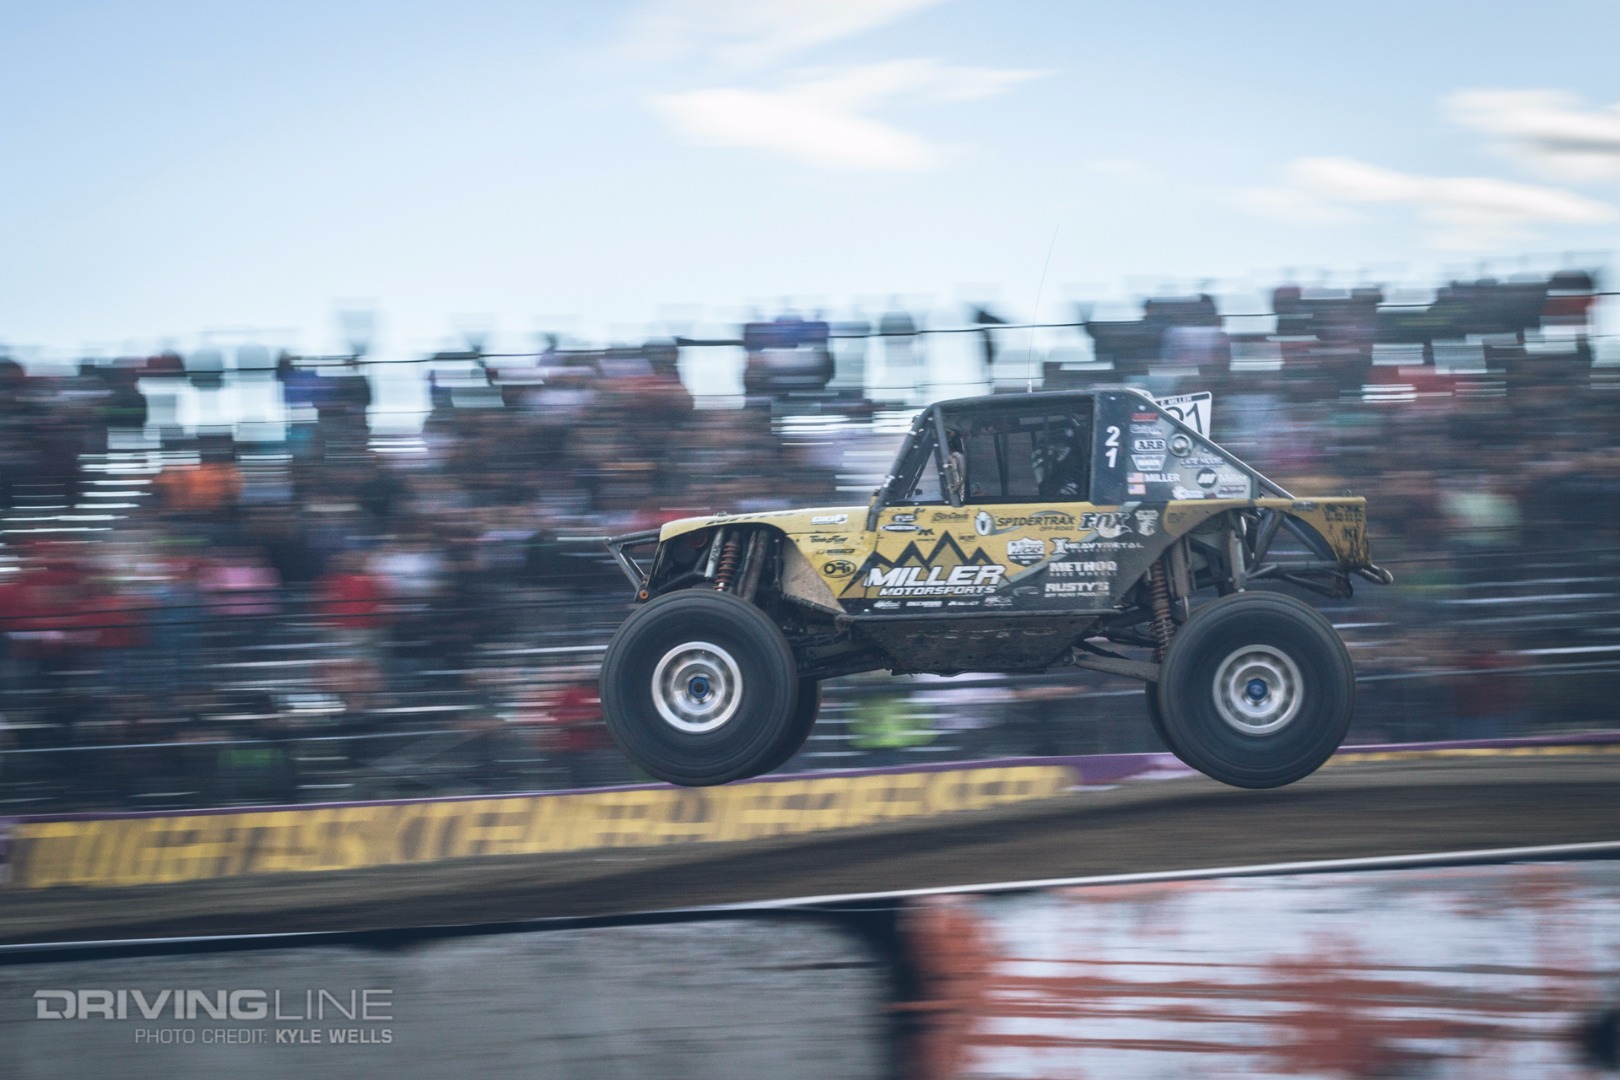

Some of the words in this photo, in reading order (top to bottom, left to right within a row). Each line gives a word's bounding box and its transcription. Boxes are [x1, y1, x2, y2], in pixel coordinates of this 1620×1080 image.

[1145, 473, 1181, 482] MILLER
[996, 516, 1076, 526] SPIDERTRAX
[1078, 512, 1133, 532] FOX
[1049, 561, 1118, 572] METHOD
[864, 565, 1006, 587] MILLER
[879, 586, 997, 596] MOTORSPORTS
[1045, 582, 1110, 592] RUSTY'S
